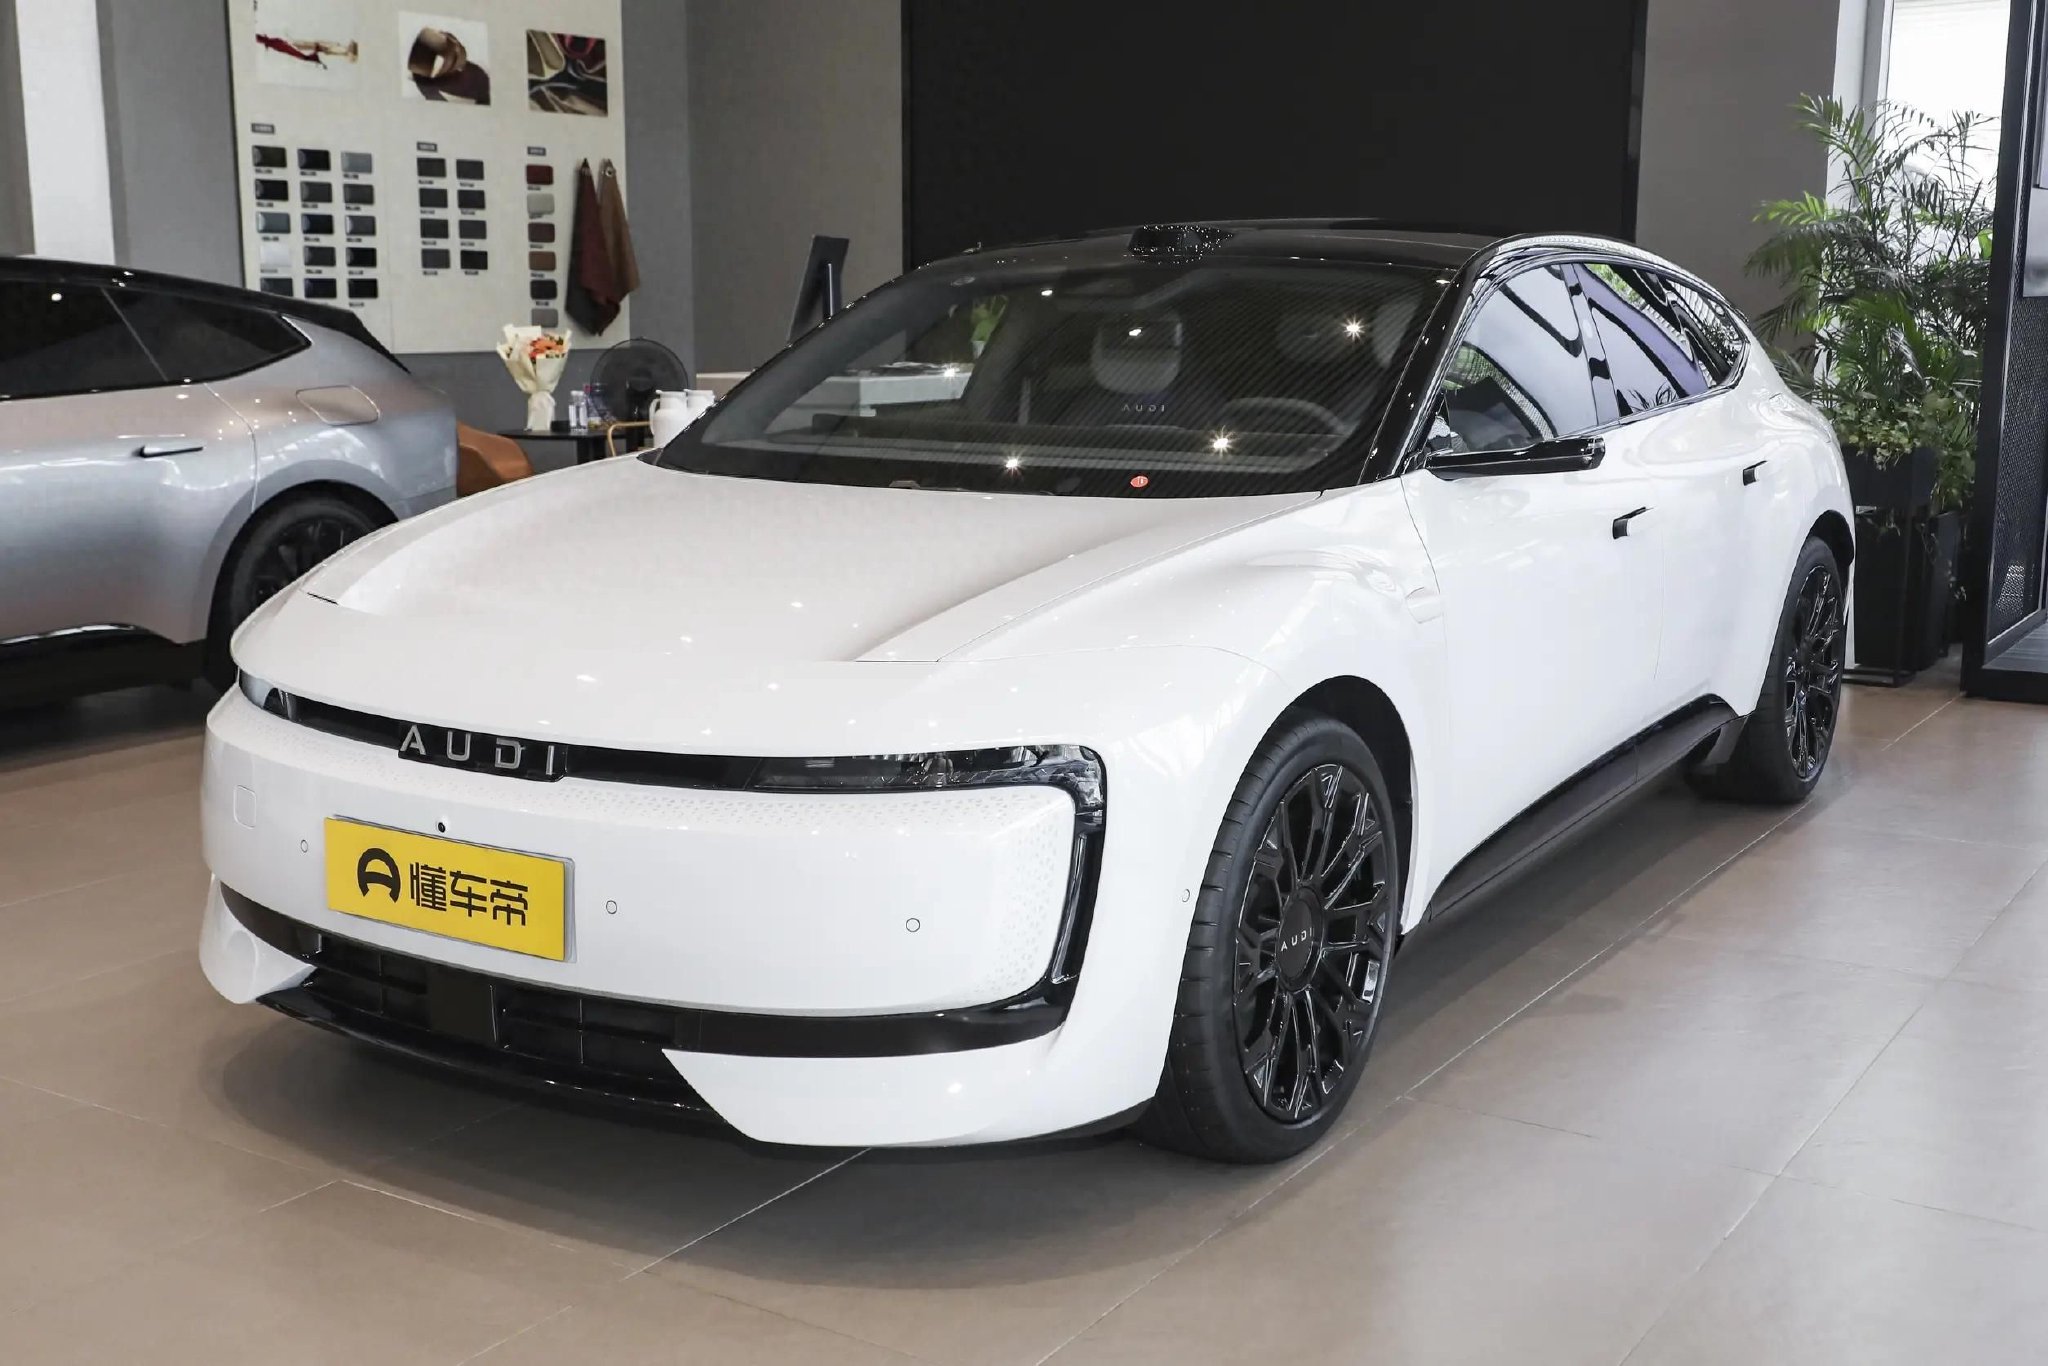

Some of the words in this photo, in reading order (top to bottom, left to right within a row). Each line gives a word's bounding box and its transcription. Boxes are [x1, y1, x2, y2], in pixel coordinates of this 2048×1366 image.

[400, 724, 555, 776] AUDI
[410, 862, 529, 927] 懂车帝
[1280, 927, 1314, 952] AUDI
